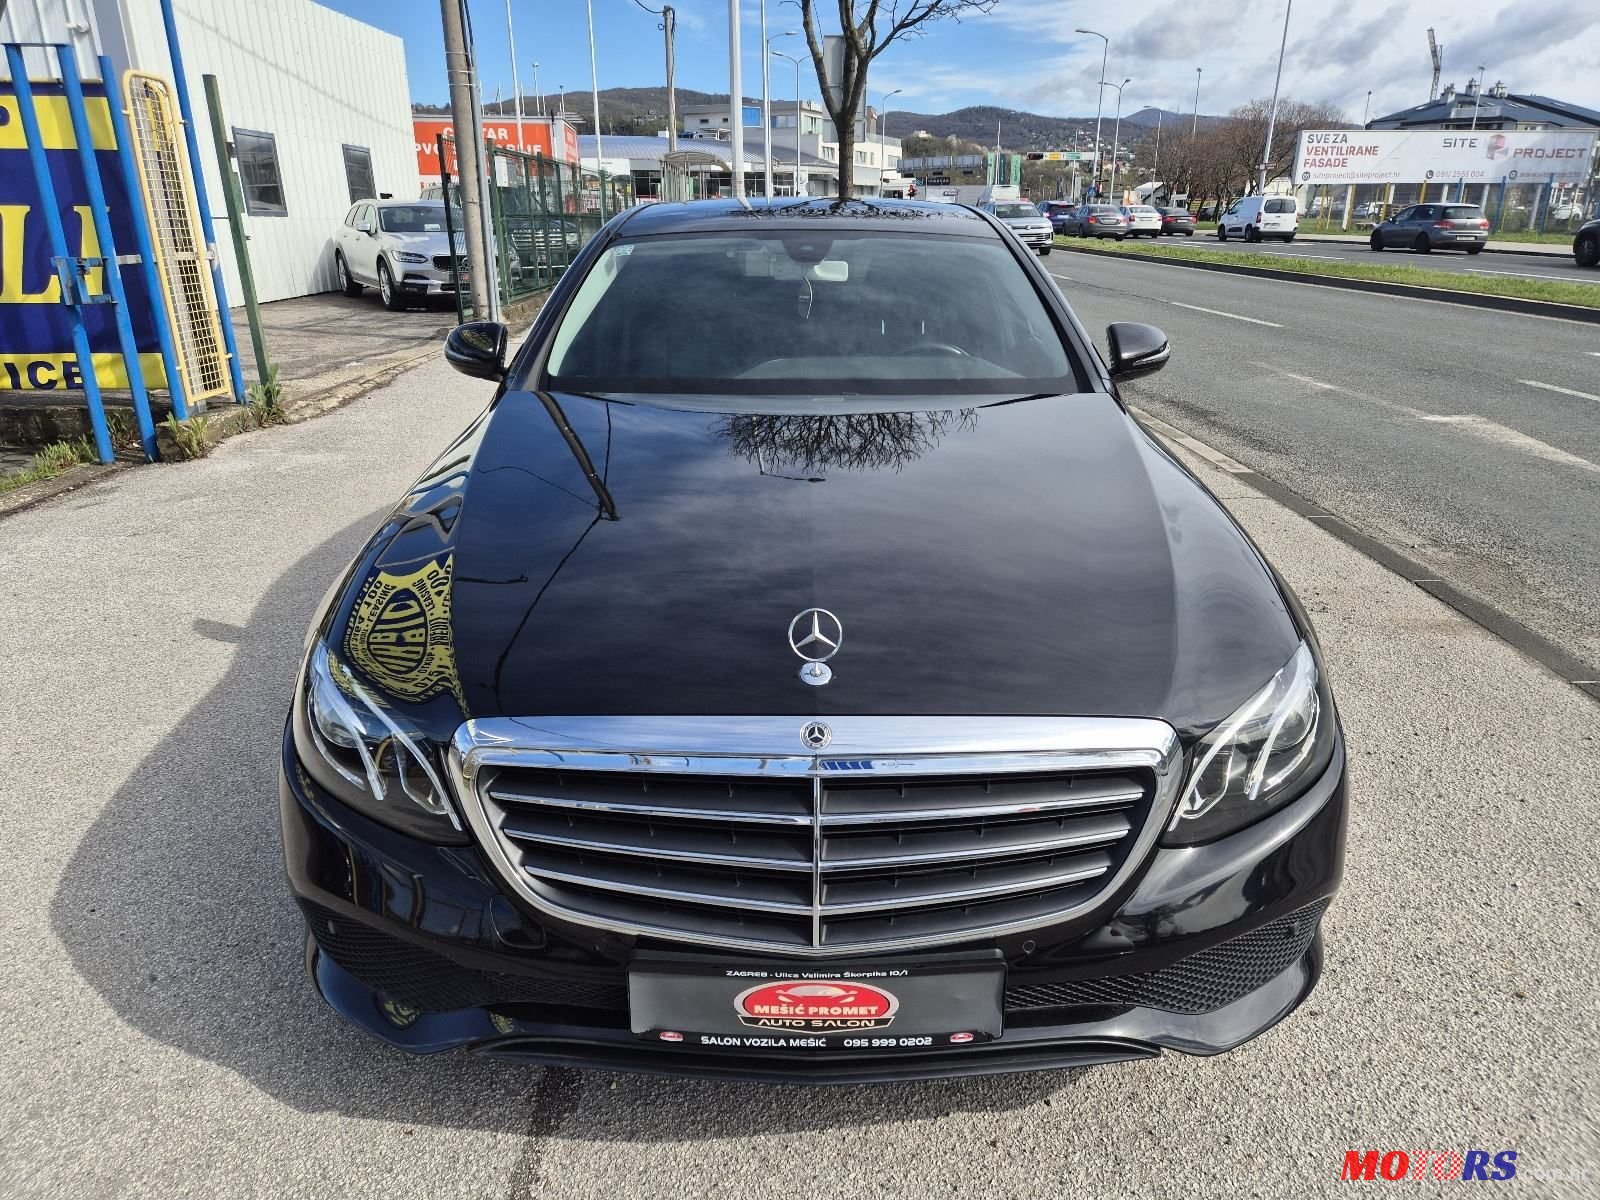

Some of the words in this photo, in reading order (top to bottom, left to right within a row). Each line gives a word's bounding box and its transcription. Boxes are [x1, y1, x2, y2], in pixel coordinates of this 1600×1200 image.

[1307, 133, 1330, 144] SVE
[1331, 133, 1348, 144] ZA
[1306, 145, 1379, 156] VENTILIRANE
[1442, 138, 1478, 148] SITE
[1513, 148, 1587, 159] PROJECT
[1303, 158, 1348, 168] FASADE
[725, 970, 768, 978] ZAGREB
[775, 971, 799, 979] Ulica
[801, 971, 841, 979] Velimira
[843, 969, 887, 979] Škorpika
[753, 1003, 805, 1015] MEŠIĆ
[808, 1005, 878, 1016] PROMET
[757, 1018, 806, 1027] AUTO
[811, 1019, 875, 1027] SALON
[700, 1035, 741, 1046] SALON
[743, 1036, 787, 1047] VOZILA
[789, 1036, 827, 1047] MEŠIĆ
[843, 1038, 869, 1047] 095
[871, 1037, 897, 1047] 999
[899, 1037, 933, 1046] 0202
